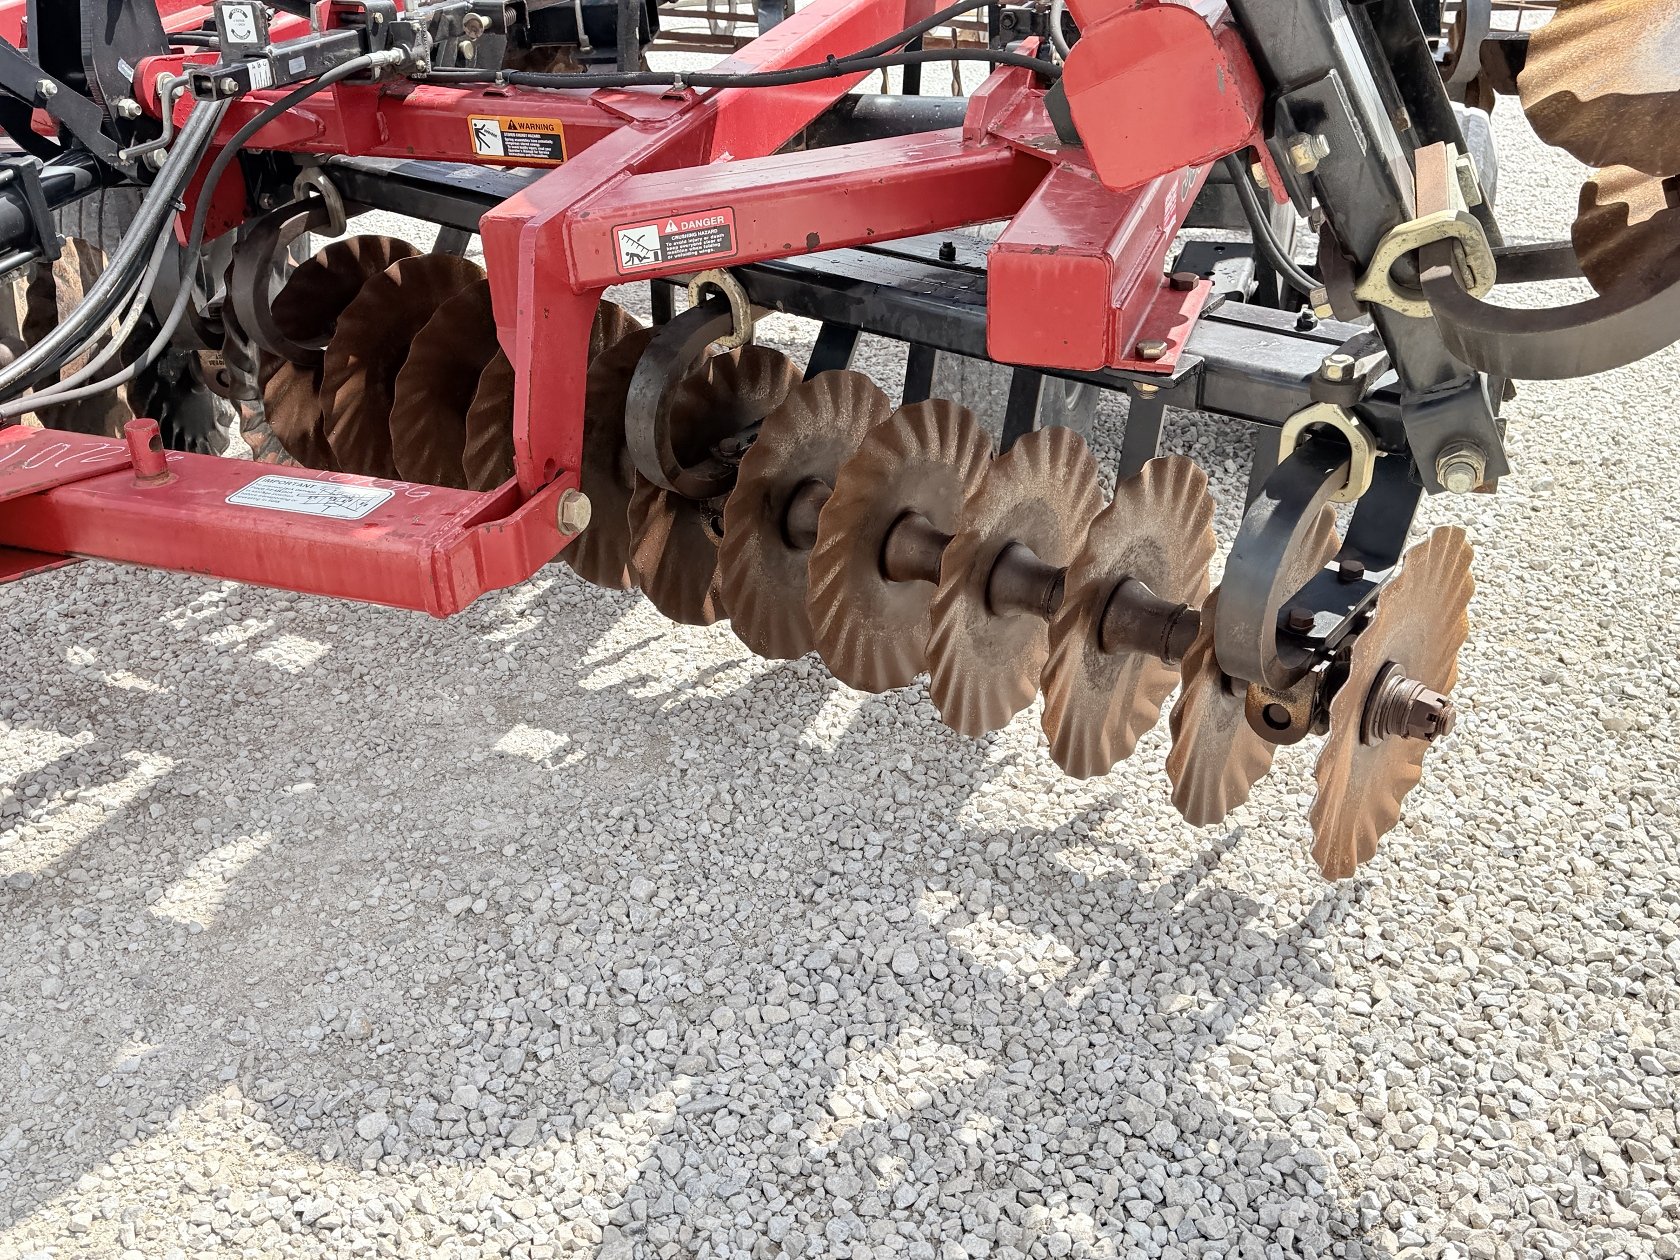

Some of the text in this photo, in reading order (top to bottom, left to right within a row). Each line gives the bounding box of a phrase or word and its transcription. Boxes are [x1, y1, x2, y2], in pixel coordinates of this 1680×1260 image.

[517, 122, 554, 131] WARNING
[681, 216, 725, 230] DANGER
[671, 232, 697, 241] CRUSHING
[680, 241, 702, 249] everyone
[262, 478, 317, 488] IMPORTANT
